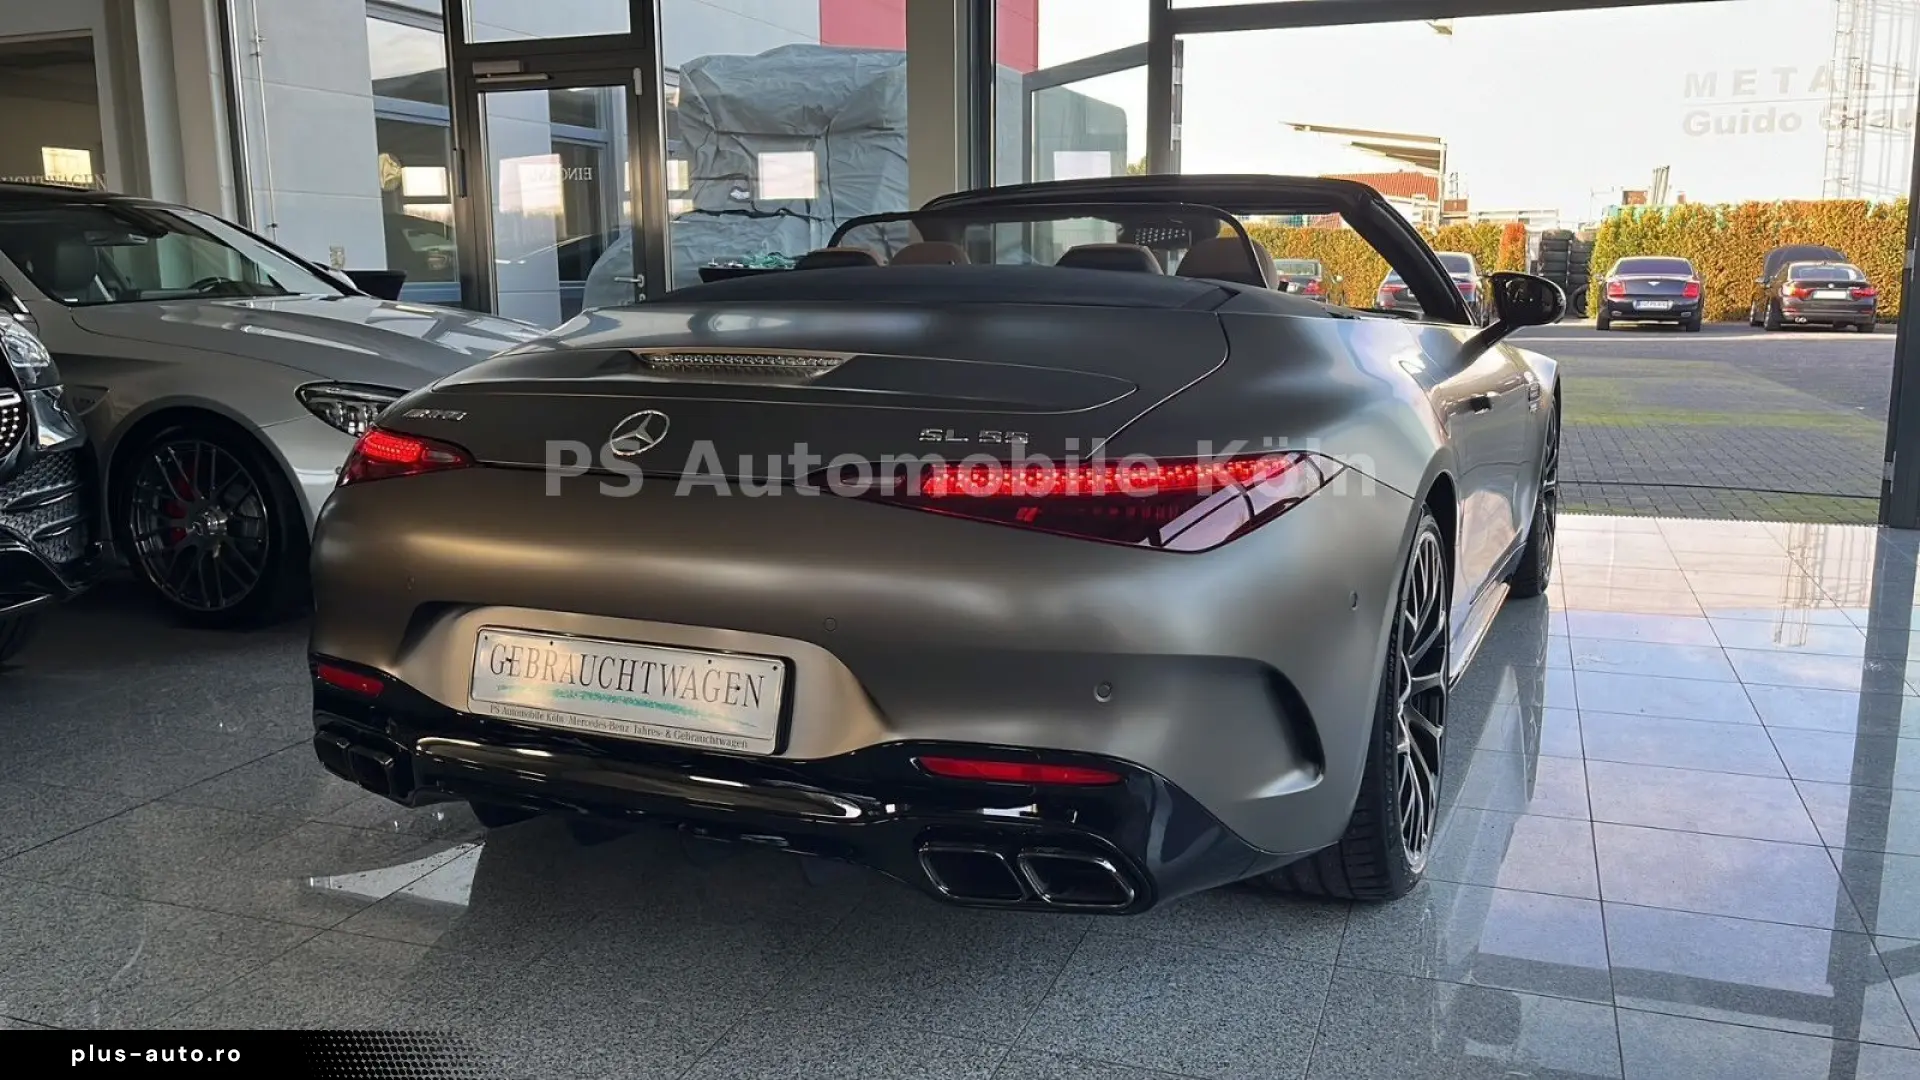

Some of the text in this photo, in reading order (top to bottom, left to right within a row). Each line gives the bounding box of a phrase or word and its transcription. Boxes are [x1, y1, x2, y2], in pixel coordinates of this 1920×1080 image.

[1682, 107, 1803, 137] Guido
[919, 428, 969, 441] SL
[490, 642, 764, 709] GEBRAUCHTWAGEN
